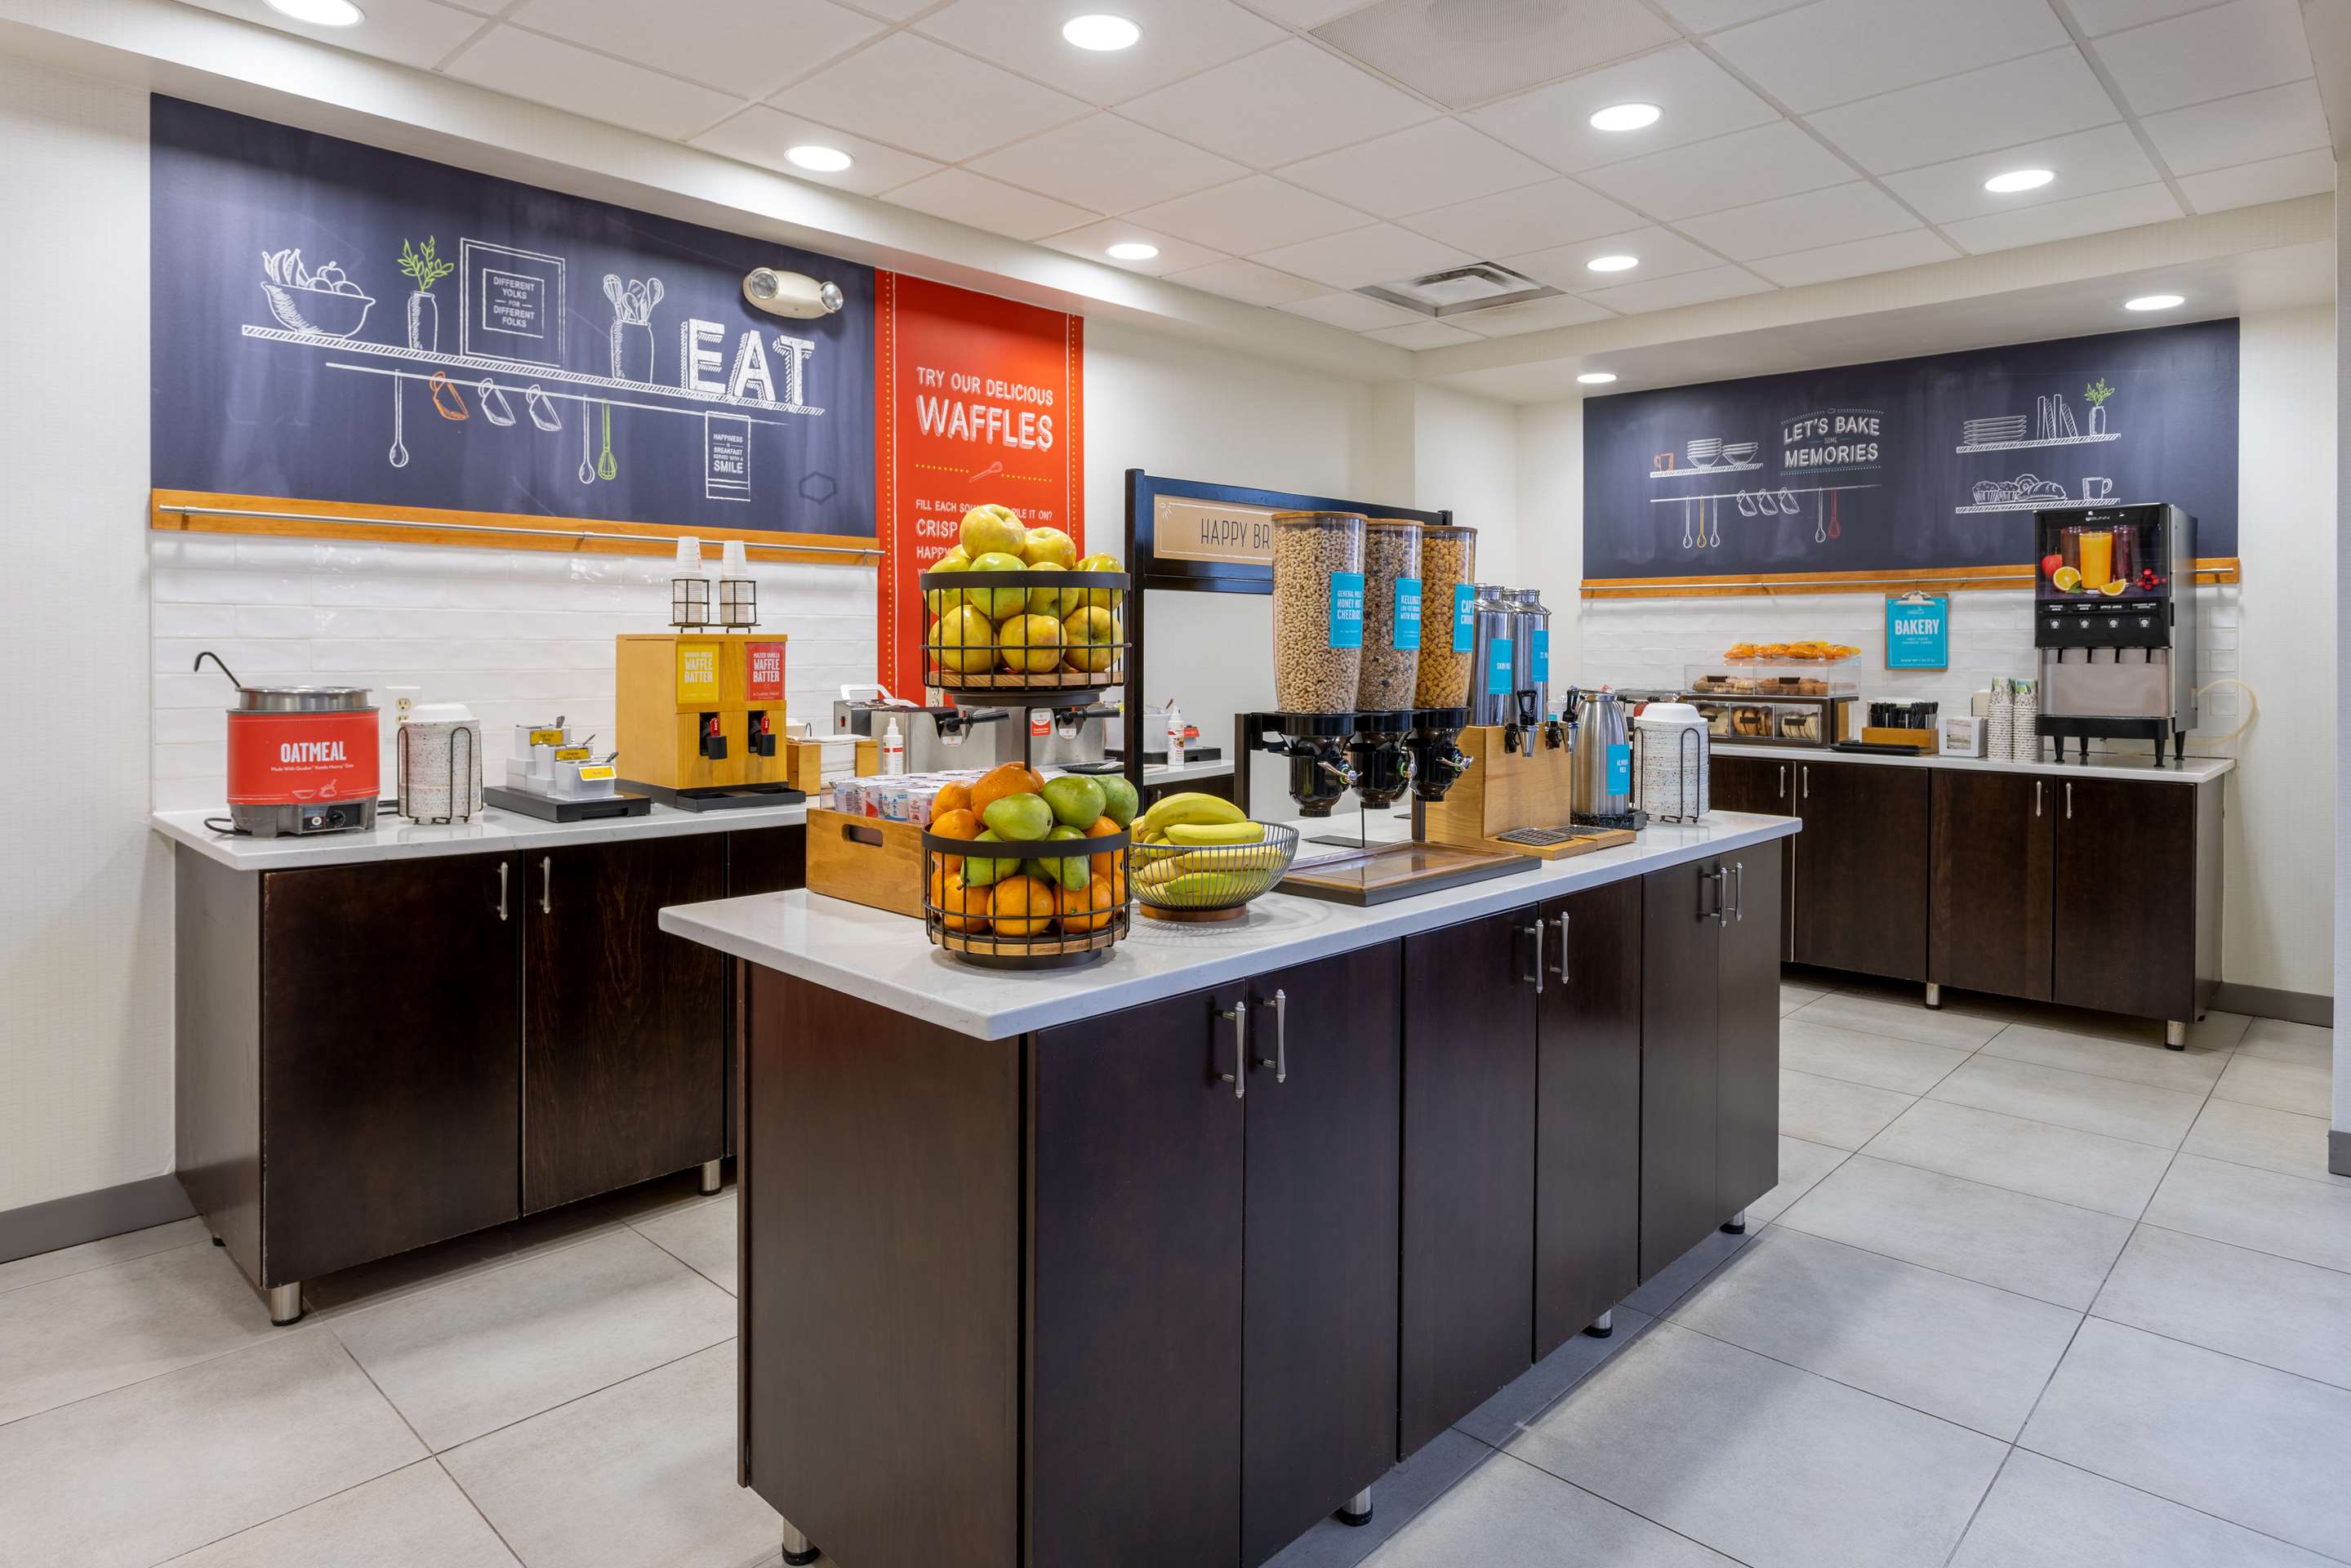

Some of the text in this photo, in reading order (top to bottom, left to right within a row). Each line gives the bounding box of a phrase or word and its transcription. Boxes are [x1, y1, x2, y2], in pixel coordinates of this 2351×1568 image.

[493, 276, 535, 291] DIFFERENT
[502, 287, 528, 300] YOLKS
[508, 300, 520, 308] FOR
[493, 305, 535, 320] DIFFERENT
[502, 316, 528, 327] FOLKS
[680, 318, 815, 406] EAT
[916, 367, 1053, 406] TRY OUR DELICIOUS
[915, 394, 1053, 452] WAFFLES
[1783, 416, 1880, 445] LET'S BAKE
[713, 433, 744, 443] HAPPINESS
[713, 446, 743, 456] BREAKFAST
[1784, 443, 1878, 468] MEMORIES
[714, 460, 744, 474] SMILE
[915, 499, 932, 510] FILL
[935, 501, 956, 513] EACH
[1029, 510, 1035, 519] IT
[1038, 510, 1053, 521] ON?
[915, 519, 958, 539] CRISP
[1201, 518, 1248, 547] HAPPY
[1337, 599, 1354, 608] HONEY
[1895, 618, 1939, 635] BAKERY
[685, 658, 713, 670] WAFFLE
[753, 658, 780, 670] WAFFLE
[684, 670, 713, 683] BATTER
[753, 670, 780, 683] BATTER
[280, 741, 346, 763] OATMEAL
